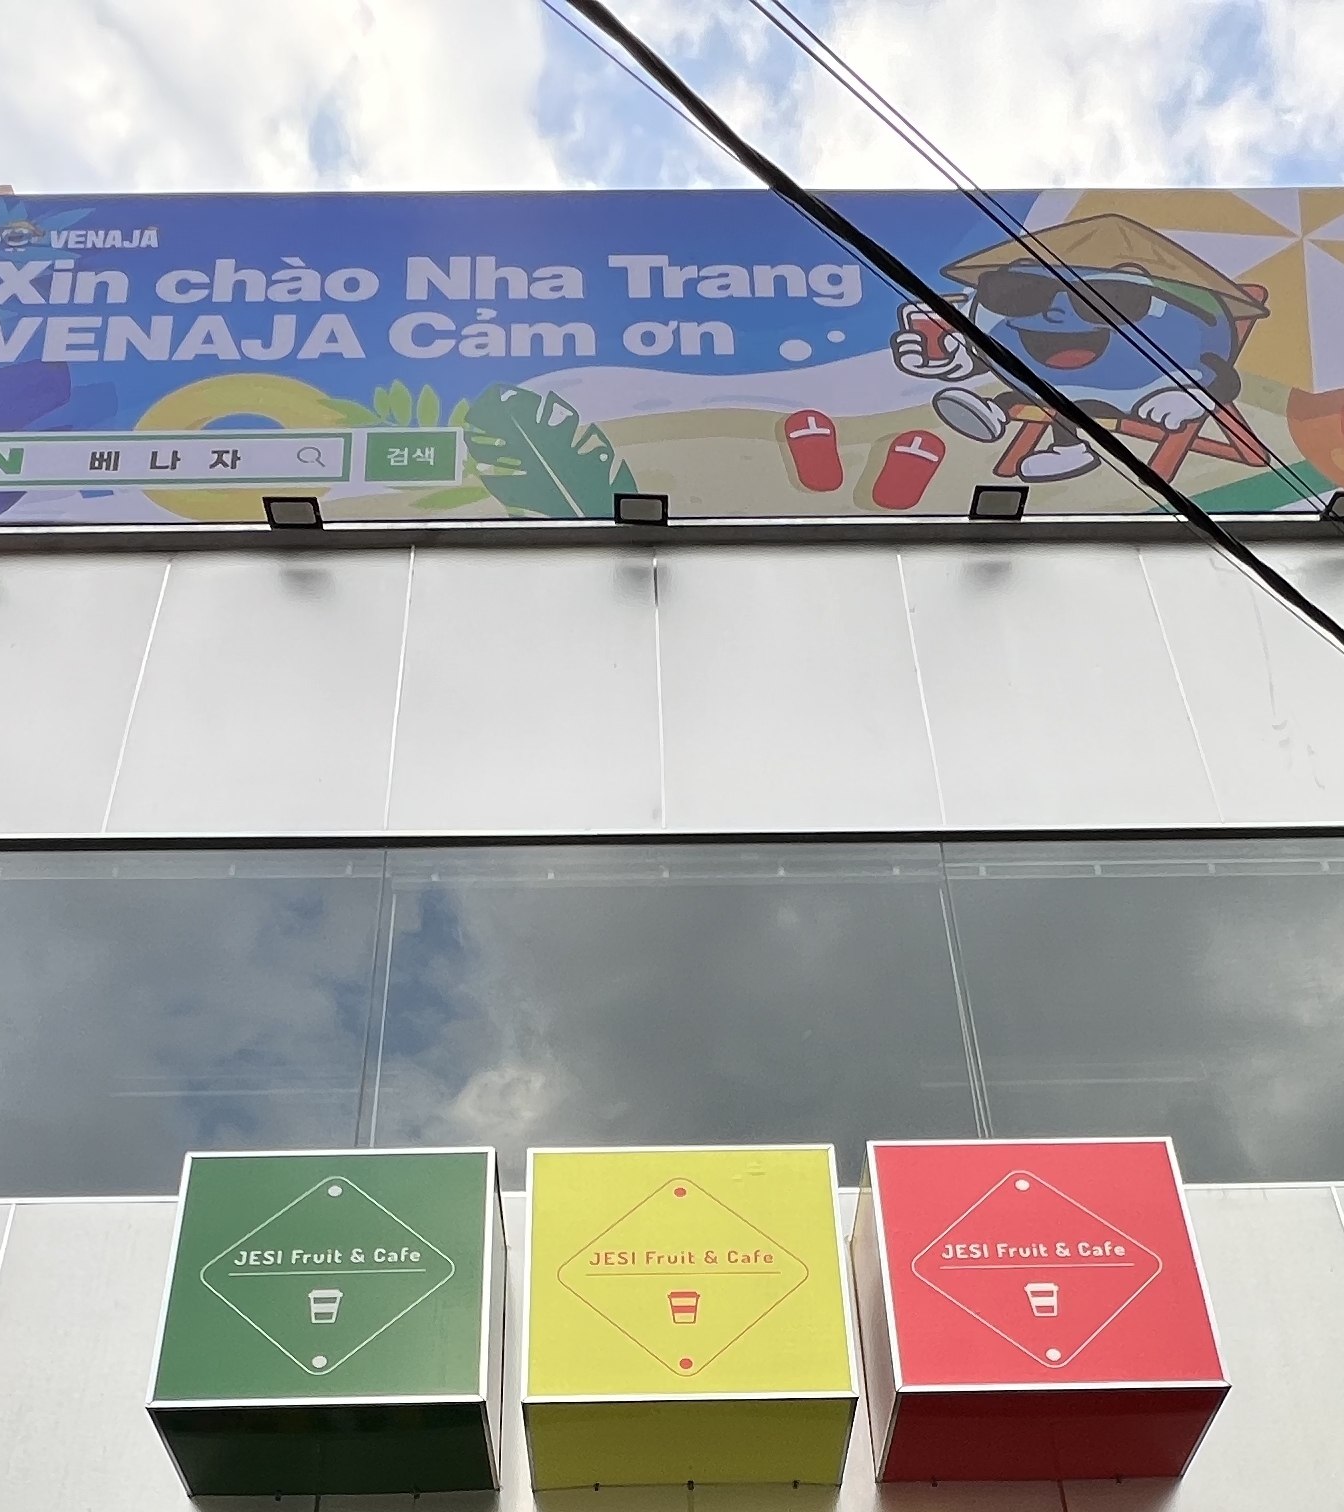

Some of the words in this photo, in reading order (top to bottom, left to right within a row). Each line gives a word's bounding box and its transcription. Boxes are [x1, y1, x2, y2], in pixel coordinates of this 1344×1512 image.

[50, 229, 159, 249] VENAJA
[155, 256, 380, 304] chào
[406, 256, 585, 301] Nha
[608, 254, 863, 307] Trang
[389, 307, 597, 359] Cảm
[622, 319, 735, 356] ơn
[386, 445, 436, 467] 검색
[233, 1248, 283, 1267] JESI
[290, 1247, 343, 1266] Fruit
[350, 1248, 367, 1265] &
[372, 1245, 421, 1265] Cafe
[588, 1249, 638, 1267] JESI
[644, 1249, 695, 1267] Fruit
[703, 1249, 721, 1266] &
[725, 1248, 774, 1266] Cafe
[940, 1243, 990, 1261] JESI
[995, 1242, 1047, 1261] Fruit
[1054, 1243, 1073, 1260] &
[1077, 1240, 1126, 1260] Cafe
